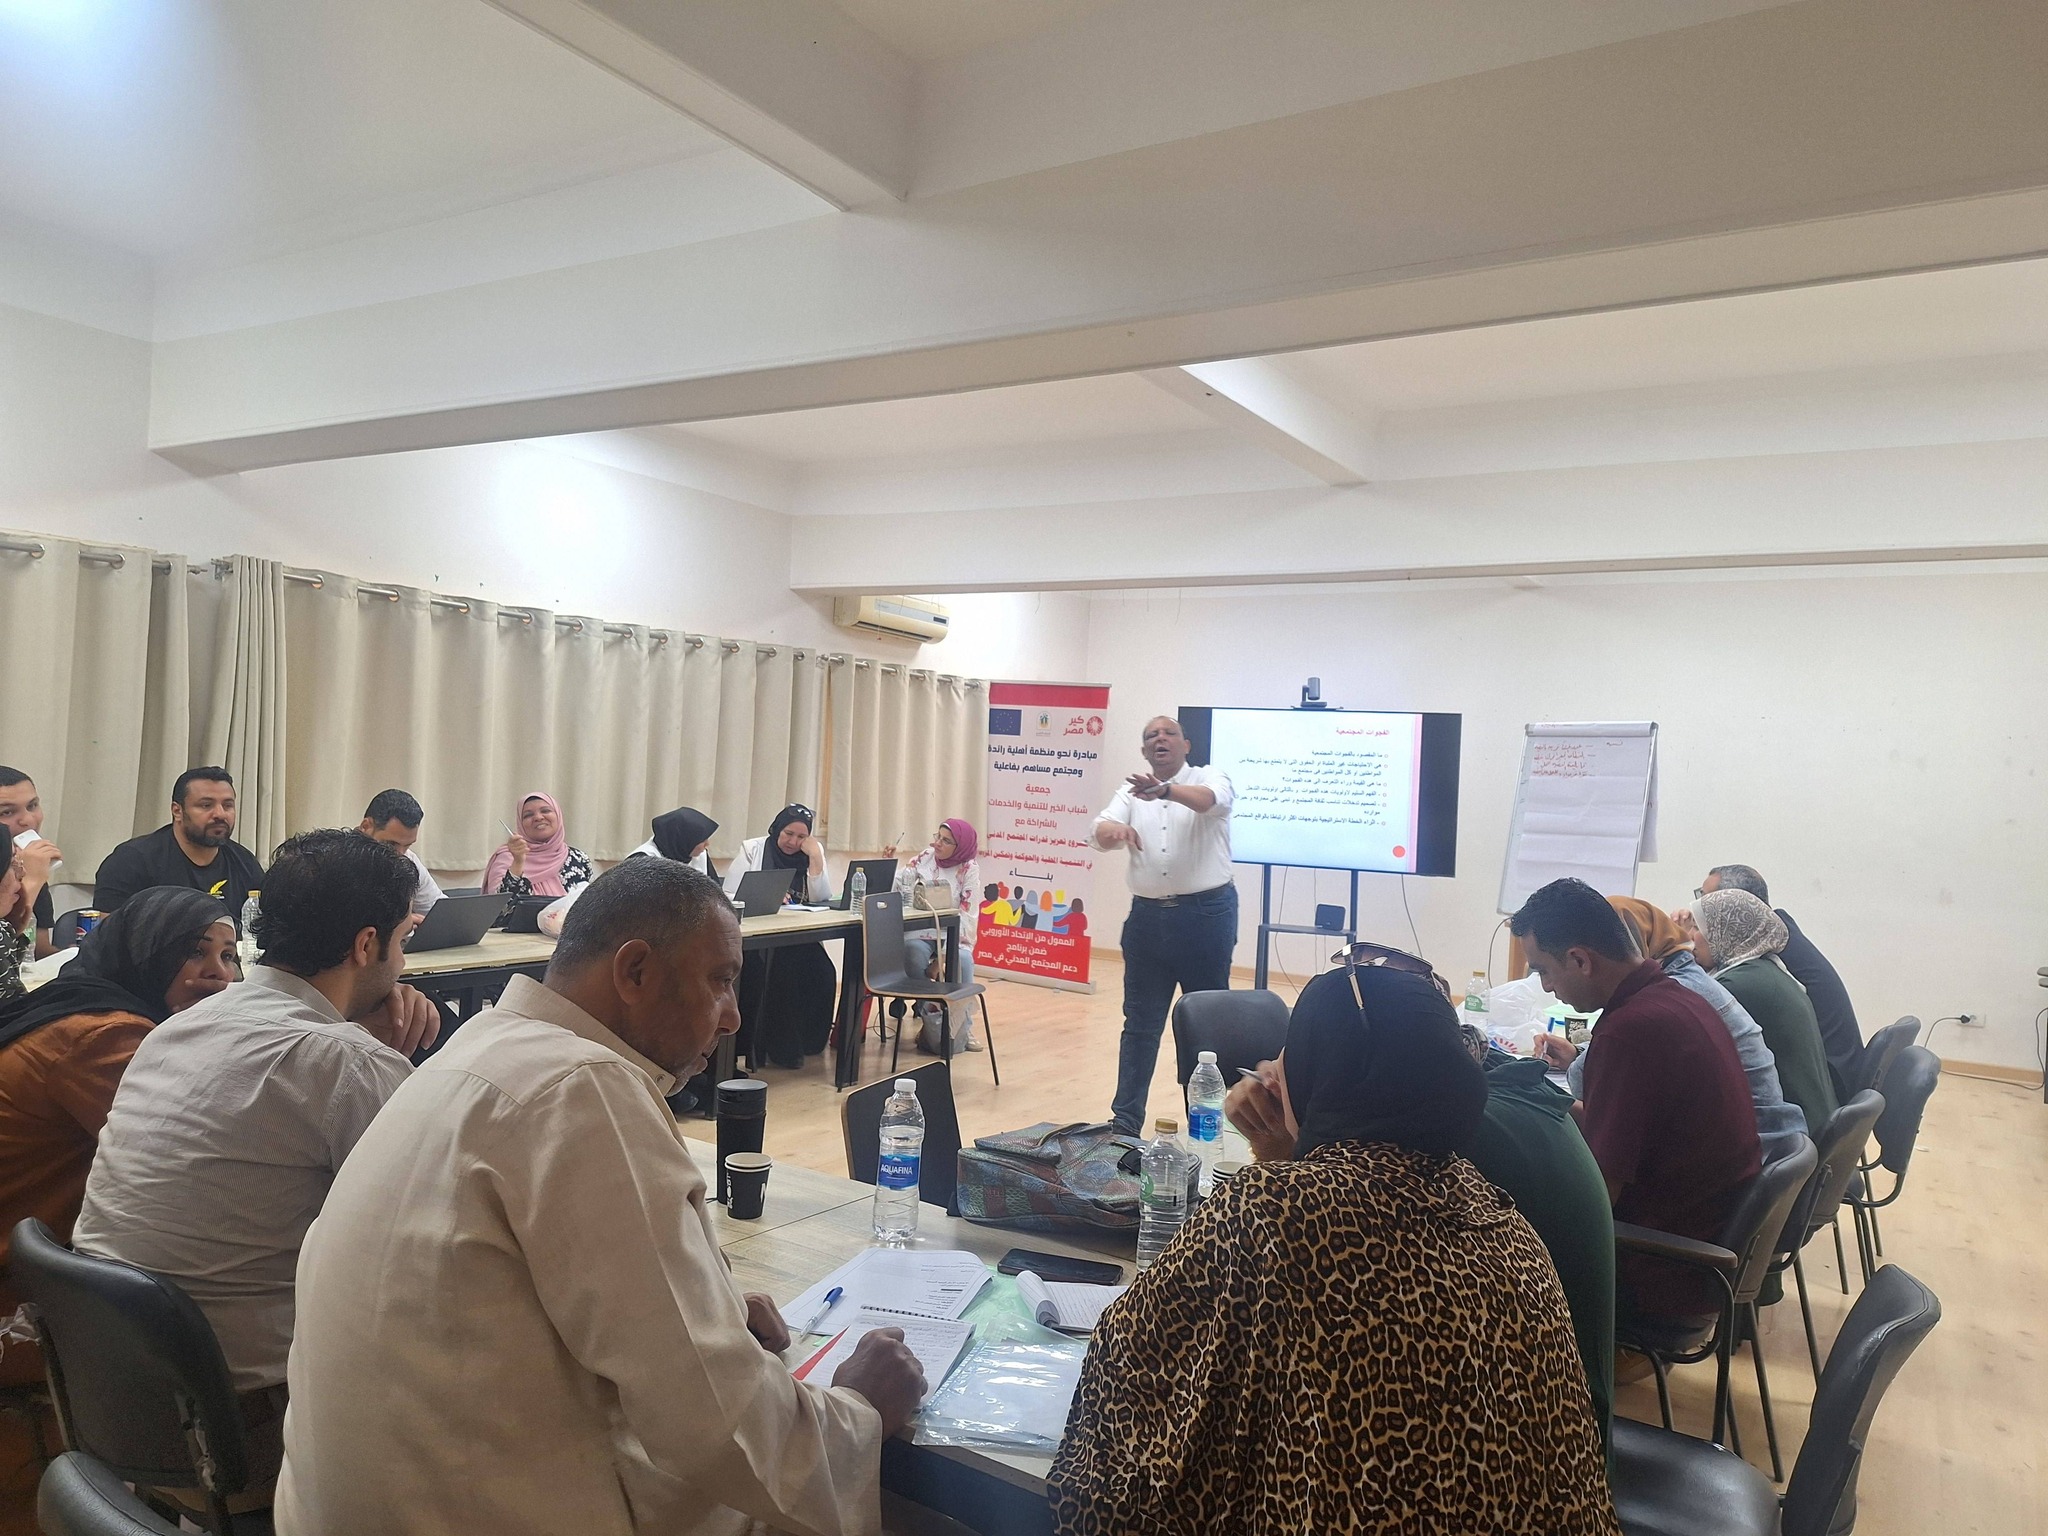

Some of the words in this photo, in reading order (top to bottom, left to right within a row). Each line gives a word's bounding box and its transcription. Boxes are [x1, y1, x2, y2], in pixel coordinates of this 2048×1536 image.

[1069, 715, 1084, 726] كير
[1063, 727, 1084, 736] مصر
[988, 744, 1005, 755] رائدة
[1007, 744, 1028, 755] أهلية
[1030, 747, 1055, 756] منظمة
[1057, 749, 1071, 759] نحو
[1073, 750, 1098, 760] مبادرة
[994, 761, 1020, 772] بفاعلية
[1022, 764, 1050, 773] مساهم
[1052, 766, 1083, 777] ومجتمع
[1026, 784, 1050, 796] جمعية
[988, 798, 1022, 810] والخدمات
[1024, 801, 1048, 811] للتنمية
[1050, 804, 1066, 813] الخير
[1068, 805, 1088, 815] شباب
[1014, 818, 1026, 827] مع
[1027, 818, 1058, 830] بالشراكة
[1068, 839, 1088, 848] شروع
[1034, 934, 1046, 944] من
[1048, 936, 1074, 946] الممول
[1006, 943, 1028, 954] برنامج
[1028, 946, 1048, 956] ضمن
[978, 950, 992, 958] مصر
[993, 953, 1004, 964] في
[1005, 955, 1030, 966] المدني
[1031, 958, 1061, 970] المجتمع
[1062, 965, 1078, 974] دعم
[880, 1163, 913, 1176] AQUAFINA
